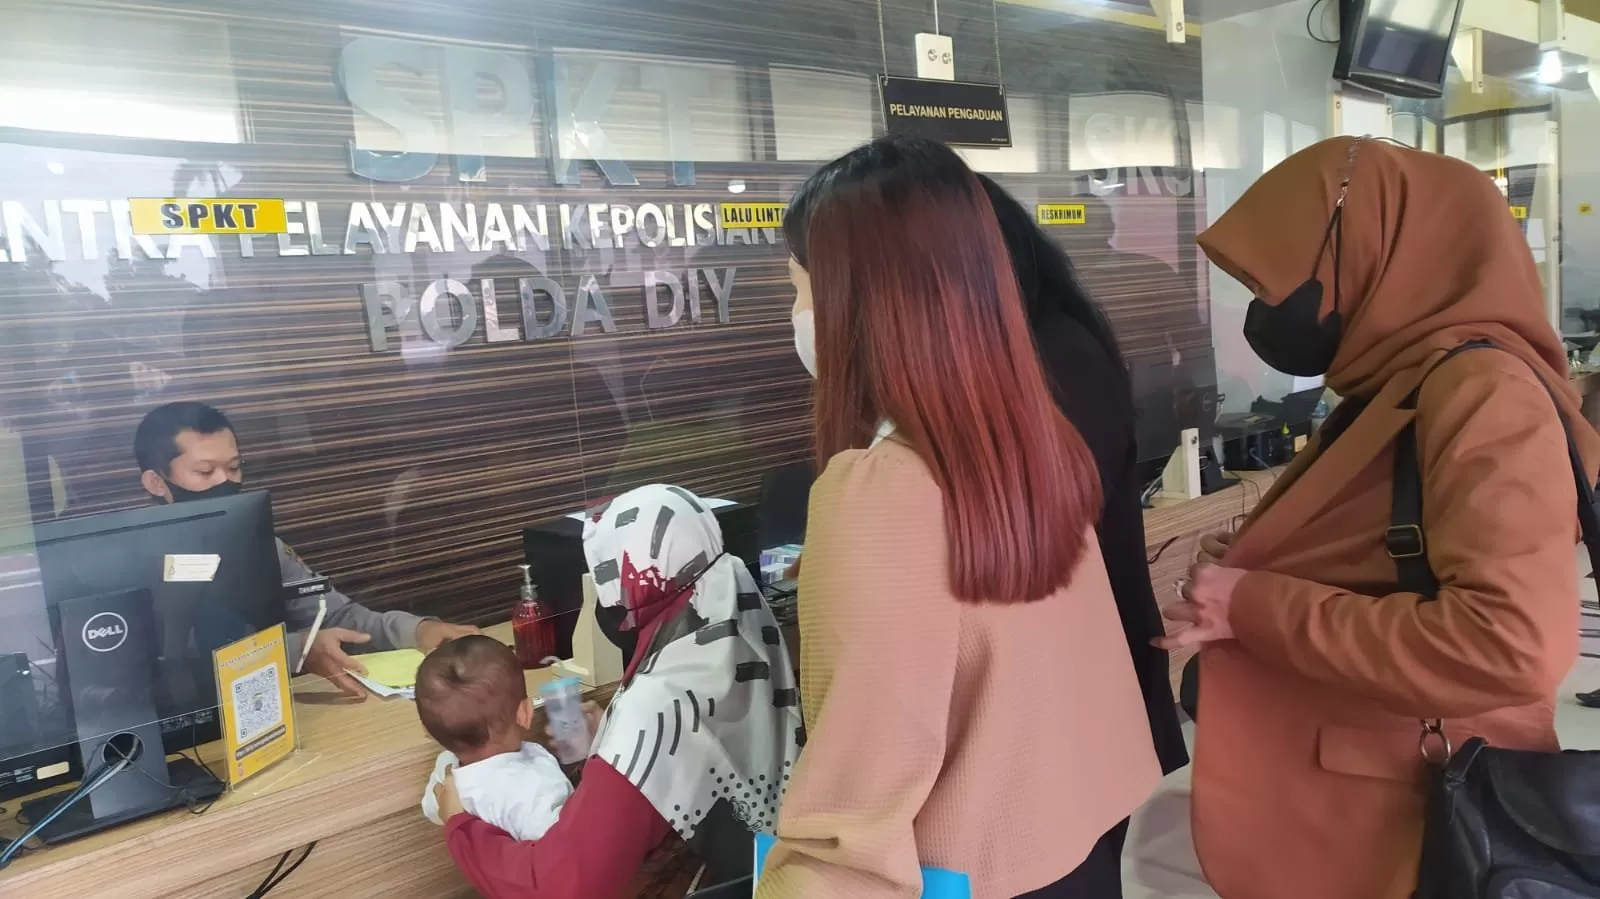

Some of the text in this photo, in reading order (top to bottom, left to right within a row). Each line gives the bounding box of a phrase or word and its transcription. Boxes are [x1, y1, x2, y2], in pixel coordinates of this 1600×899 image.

[340, 34, 722, 187] SPKT
[889, 103, 1003, 121] PELAYANAN PENGADUAN
[160, 203, 258, 229] SPKT
[723, 207, 784, 223] LALU LINT
[0, 199, 217, 262] NTR
[360, 267, 737, 352] POLDA DIY
[87, 624, 124, 640] DELL
